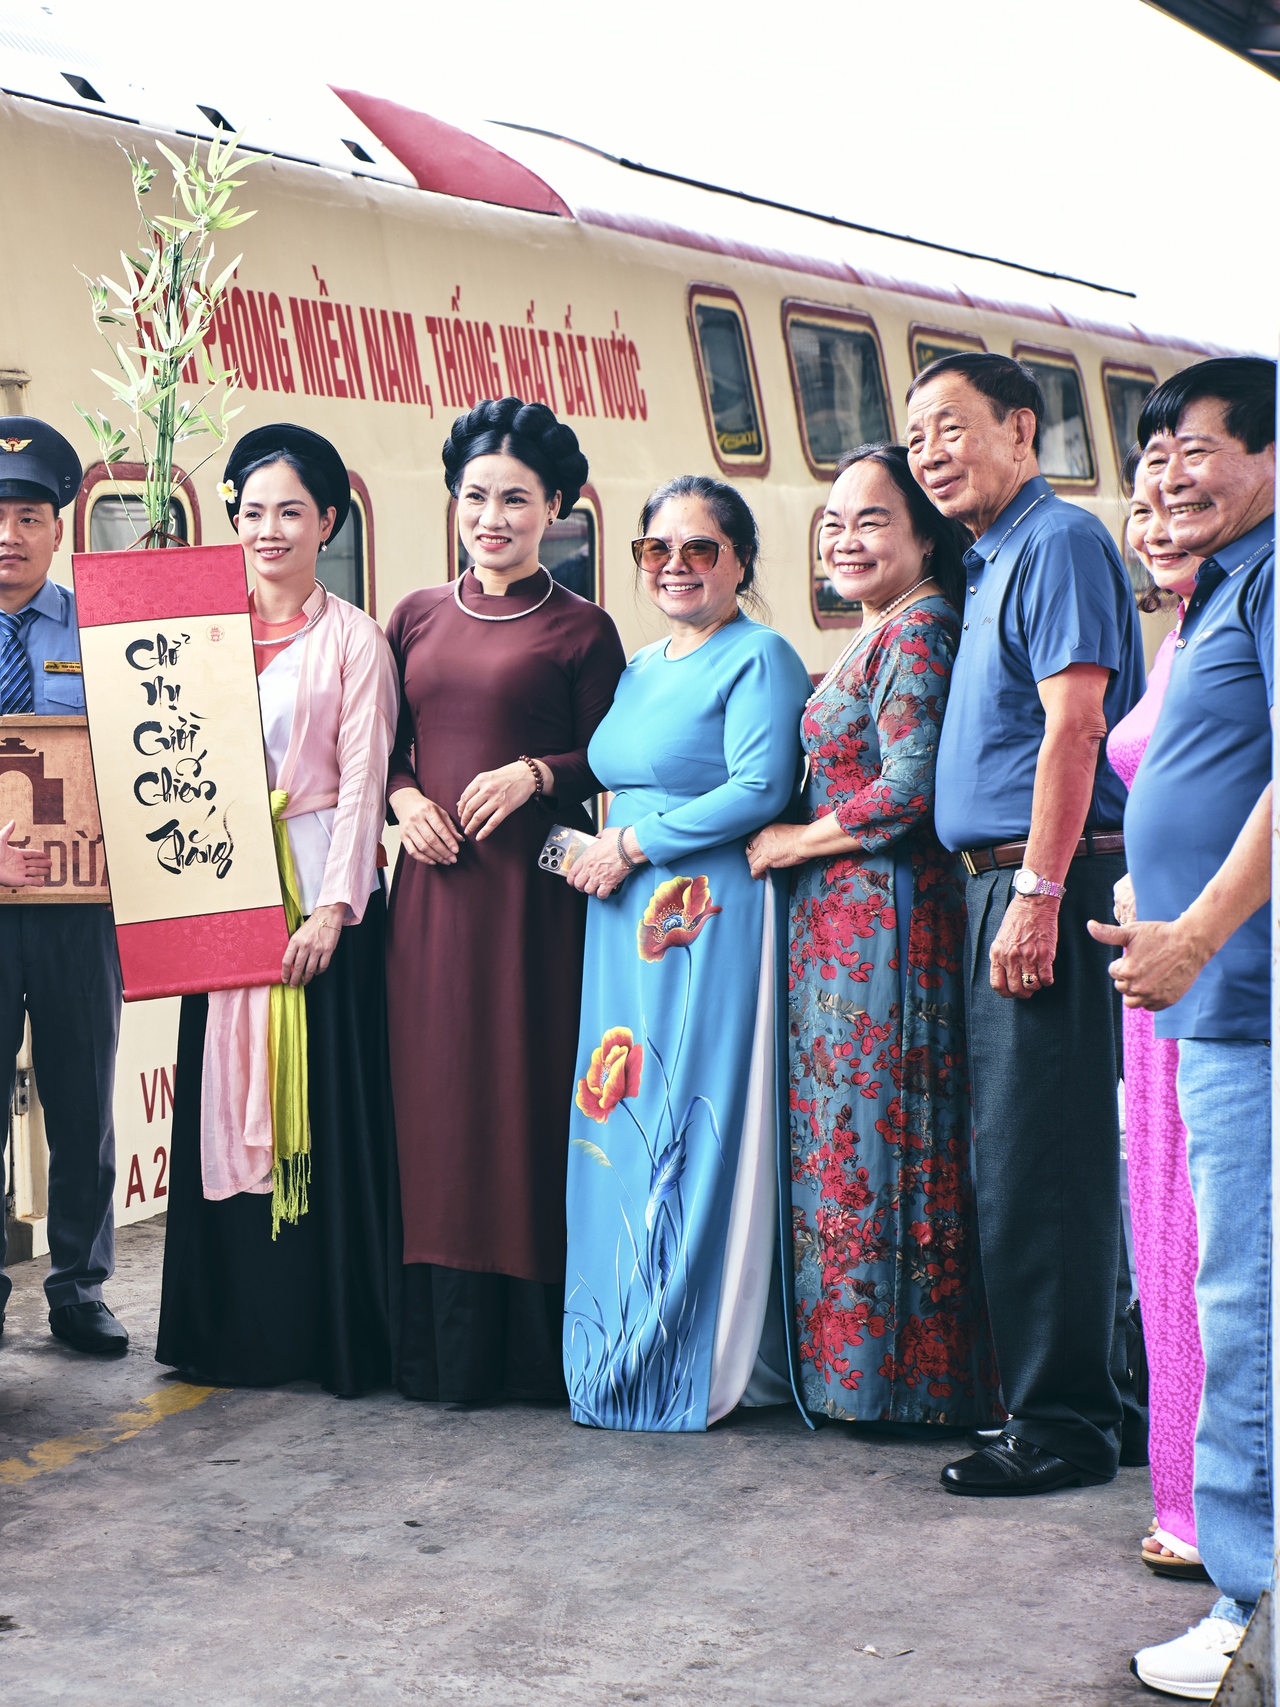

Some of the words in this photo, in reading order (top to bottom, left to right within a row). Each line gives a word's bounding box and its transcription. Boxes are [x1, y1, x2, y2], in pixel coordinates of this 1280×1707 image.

[289, 264, 366, 400] MIỀN
[359, 306, 433, 419] NAM,
[425, 285, 503, 410] THỐNG
[499, 300, 558, 415] NHẤT
[553, 304, 596, 418] ĐẤT
[590, 310, 647, 421] NƯỚC
[125, 633, 191, 671] Chở
[133, 749, 217, 806] Chiến
[44, 831, 107, 888] DỪ
[125, 1153, 146, 1208] A
